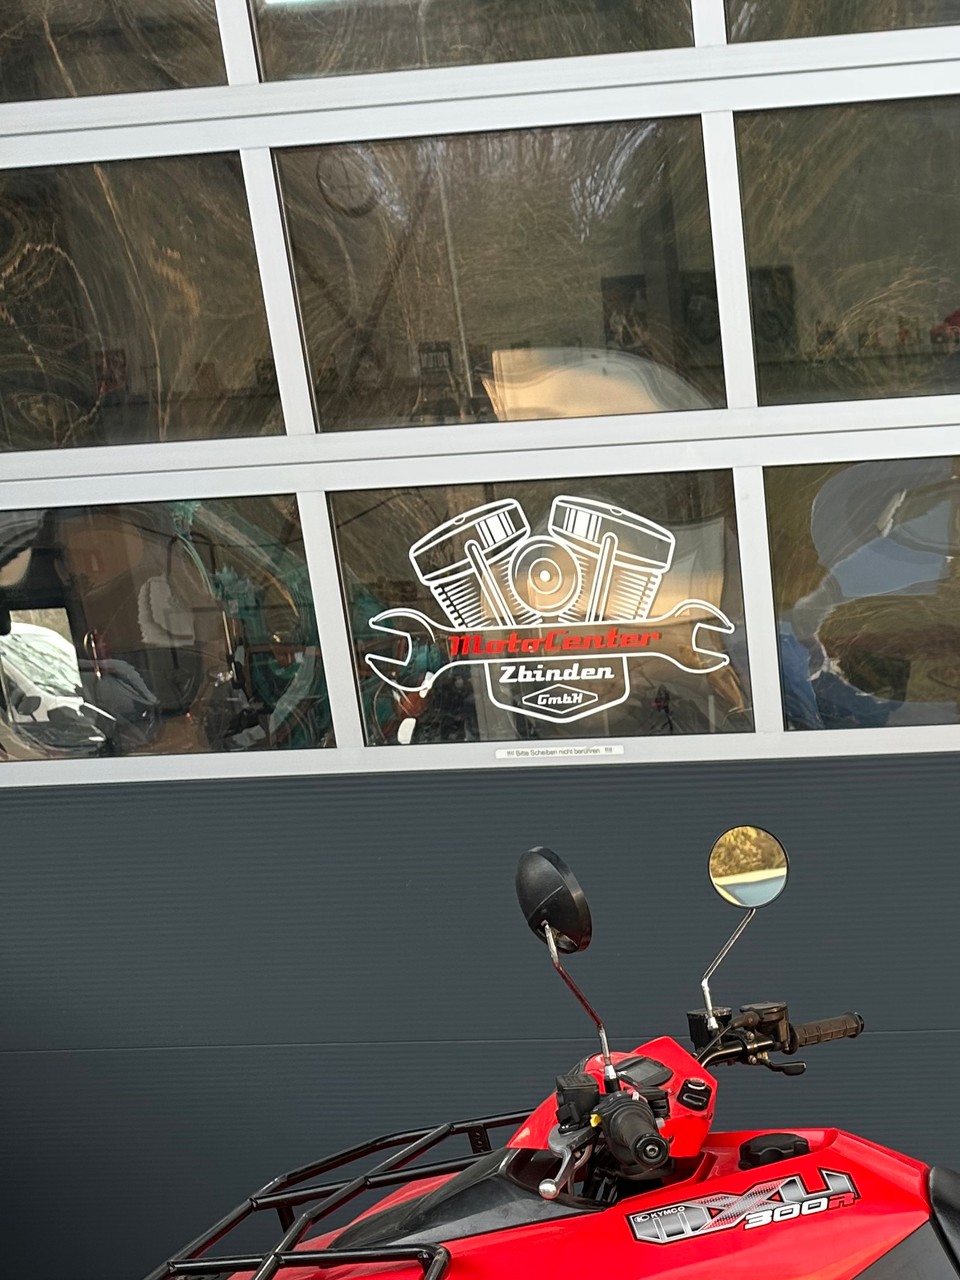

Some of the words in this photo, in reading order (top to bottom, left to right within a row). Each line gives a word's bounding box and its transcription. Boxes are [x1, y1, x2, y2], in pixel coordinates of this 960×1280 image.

[448, 627, 662, 656] MotoCenter
[499, 663, 615, 683] Zbinden
[537, 693, 583, 705] GmbH
[649, 1206, 685, 1219] KYMCO
